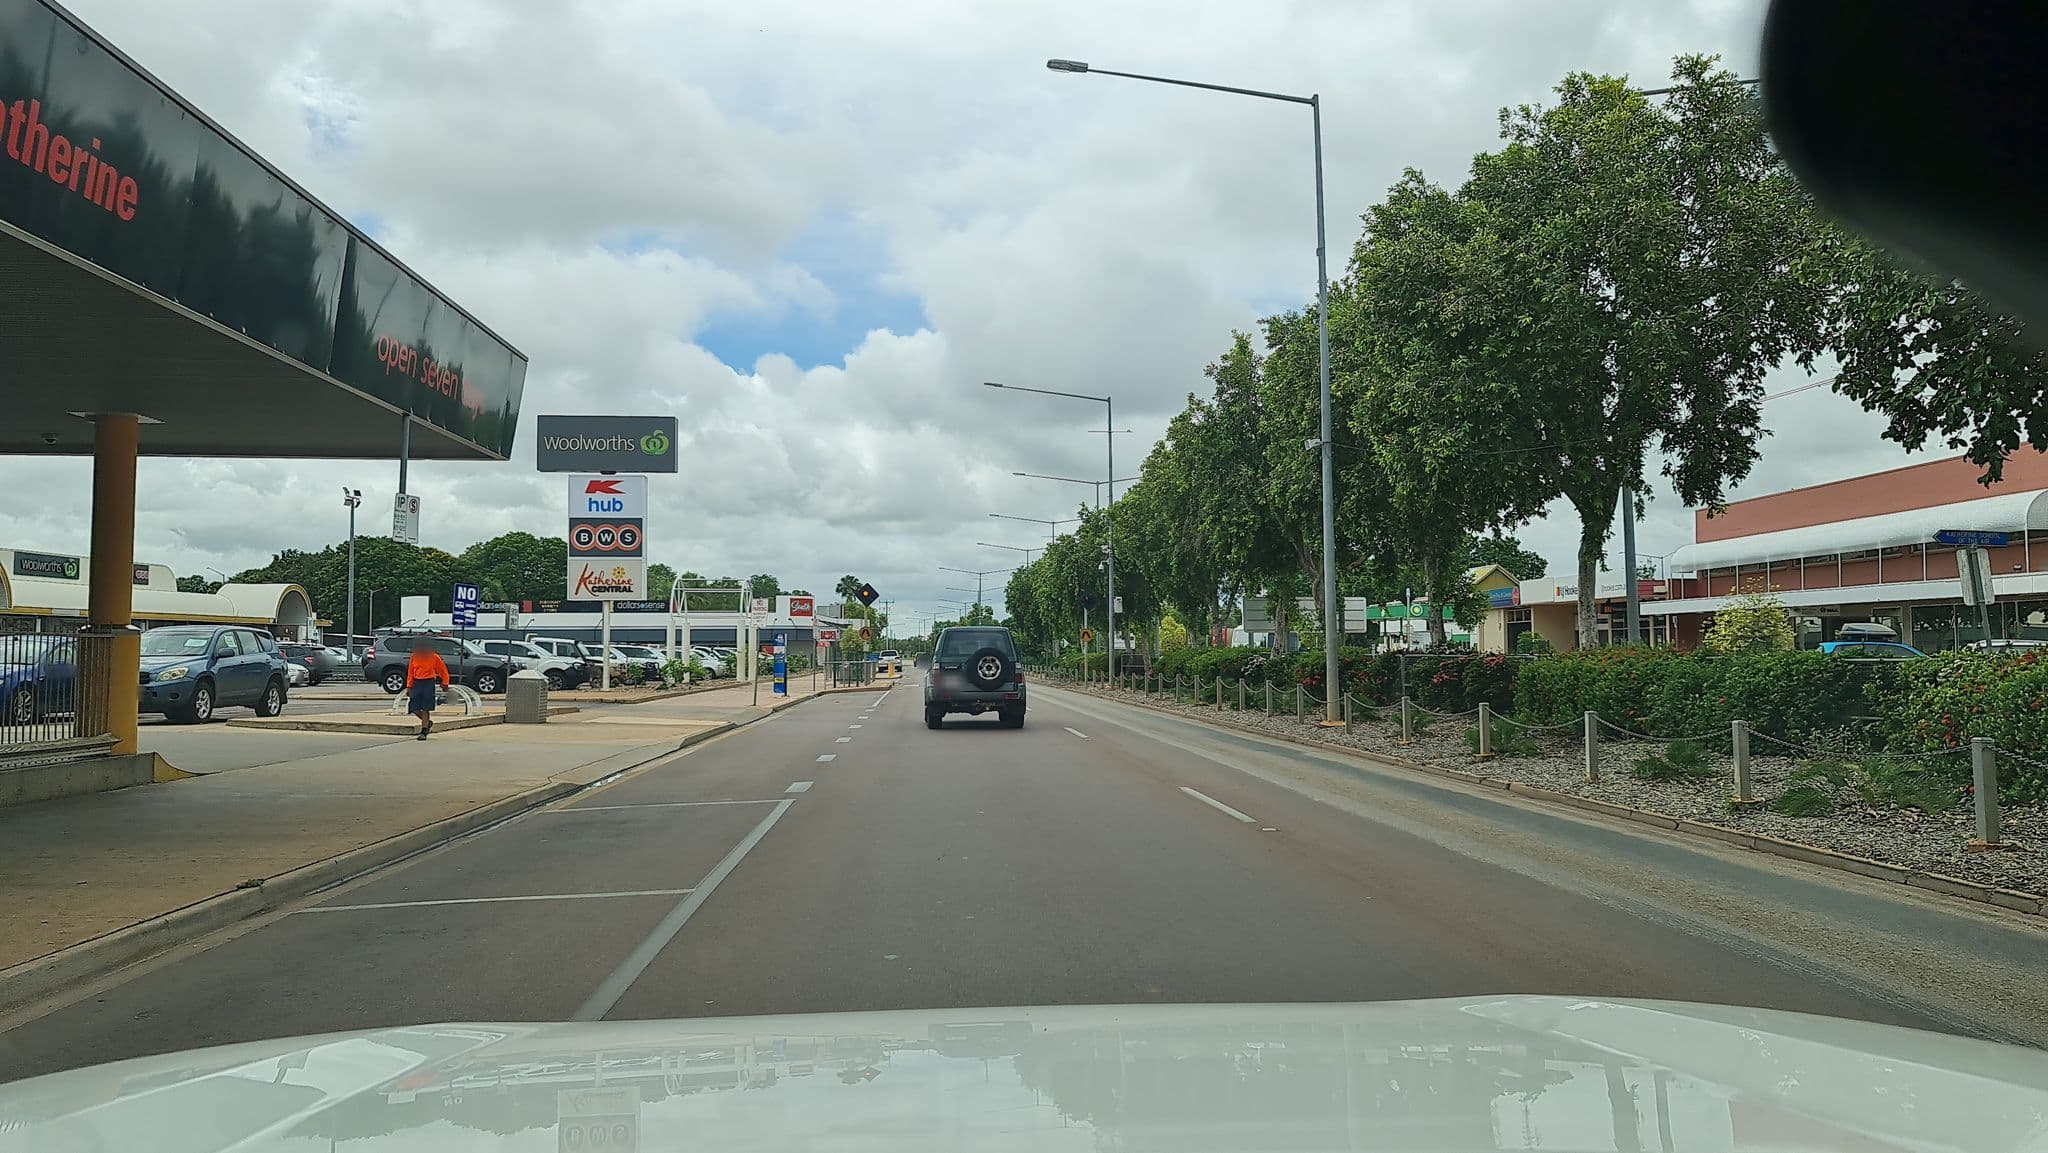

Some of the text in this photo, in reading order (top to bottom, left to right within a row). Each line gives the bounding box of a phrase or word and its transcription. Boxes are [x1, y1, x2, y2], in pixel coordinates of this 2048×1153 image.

[0, 98, 138, 221] therine
[377, 335, 418, 378] open
[420, 356, 458, 399] seven
[544, 434, 635, 451] Woolworths
[588, 498, 624, 512] hub
[575, 563, 634, 597] Katherine
[457, 586, 477, 601] NO
[591, 585, 634, 593] CENTRAL
[1565, 585, 1580, 595] Hooke
[617, 601, 665, 609] dollars sense
